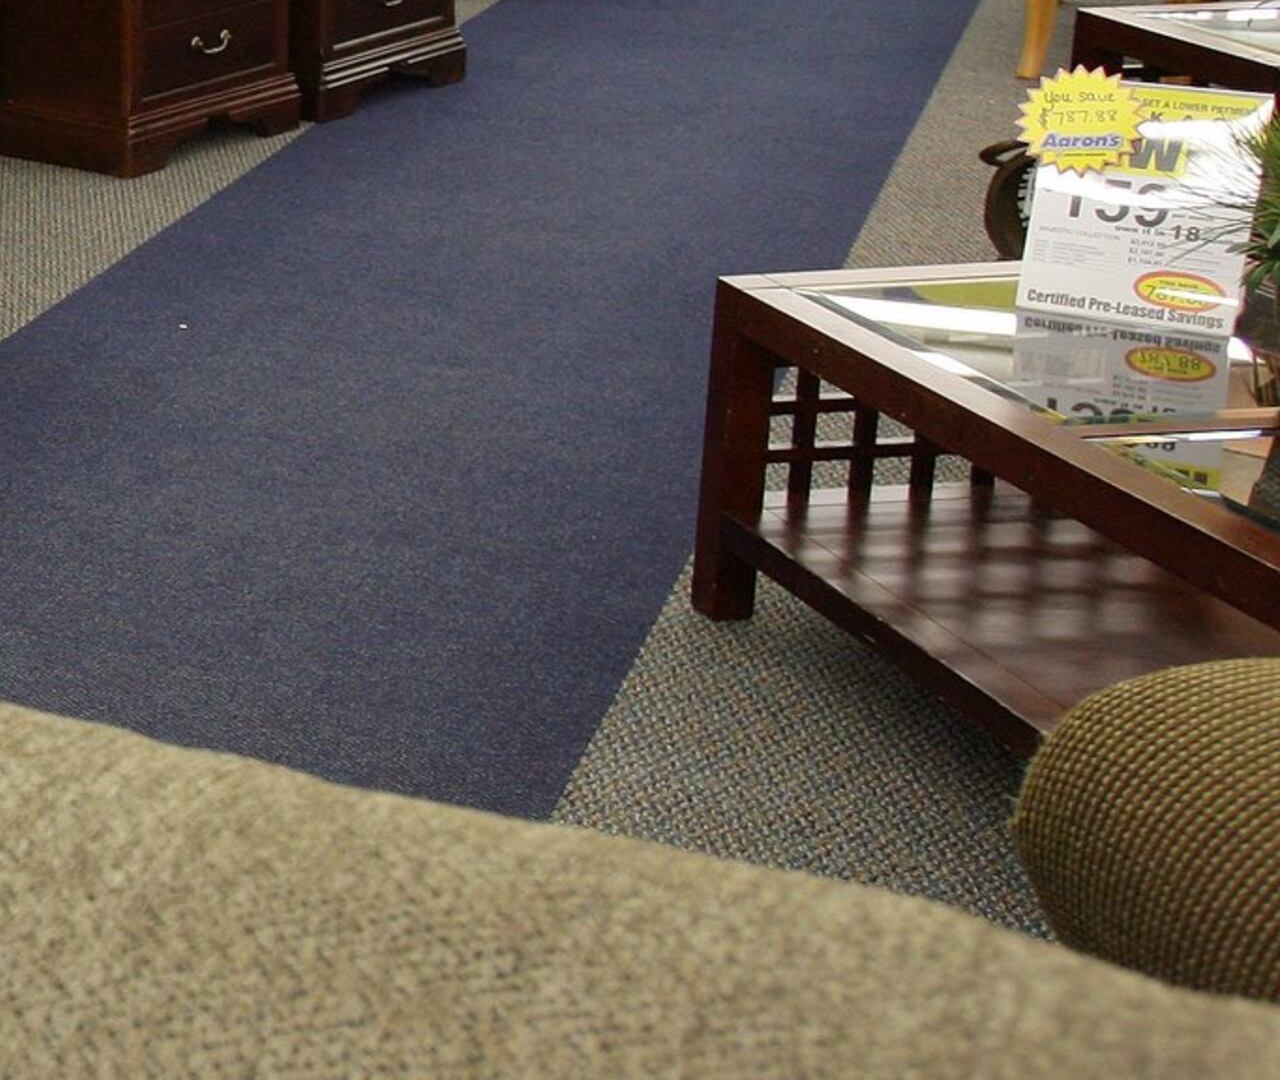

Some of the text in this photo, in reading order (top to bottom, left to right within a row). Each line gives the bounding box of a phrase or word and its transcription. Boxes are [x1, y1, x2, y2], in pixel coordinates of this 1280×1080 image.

[1173, 102, 1208, 112] LOWER
[1042, 133, 1122, 149] Aaron's
[1171, 224, 1201, 243] 18
[1026, 288, 1225, 329] Certified Pre-Leased Savings
